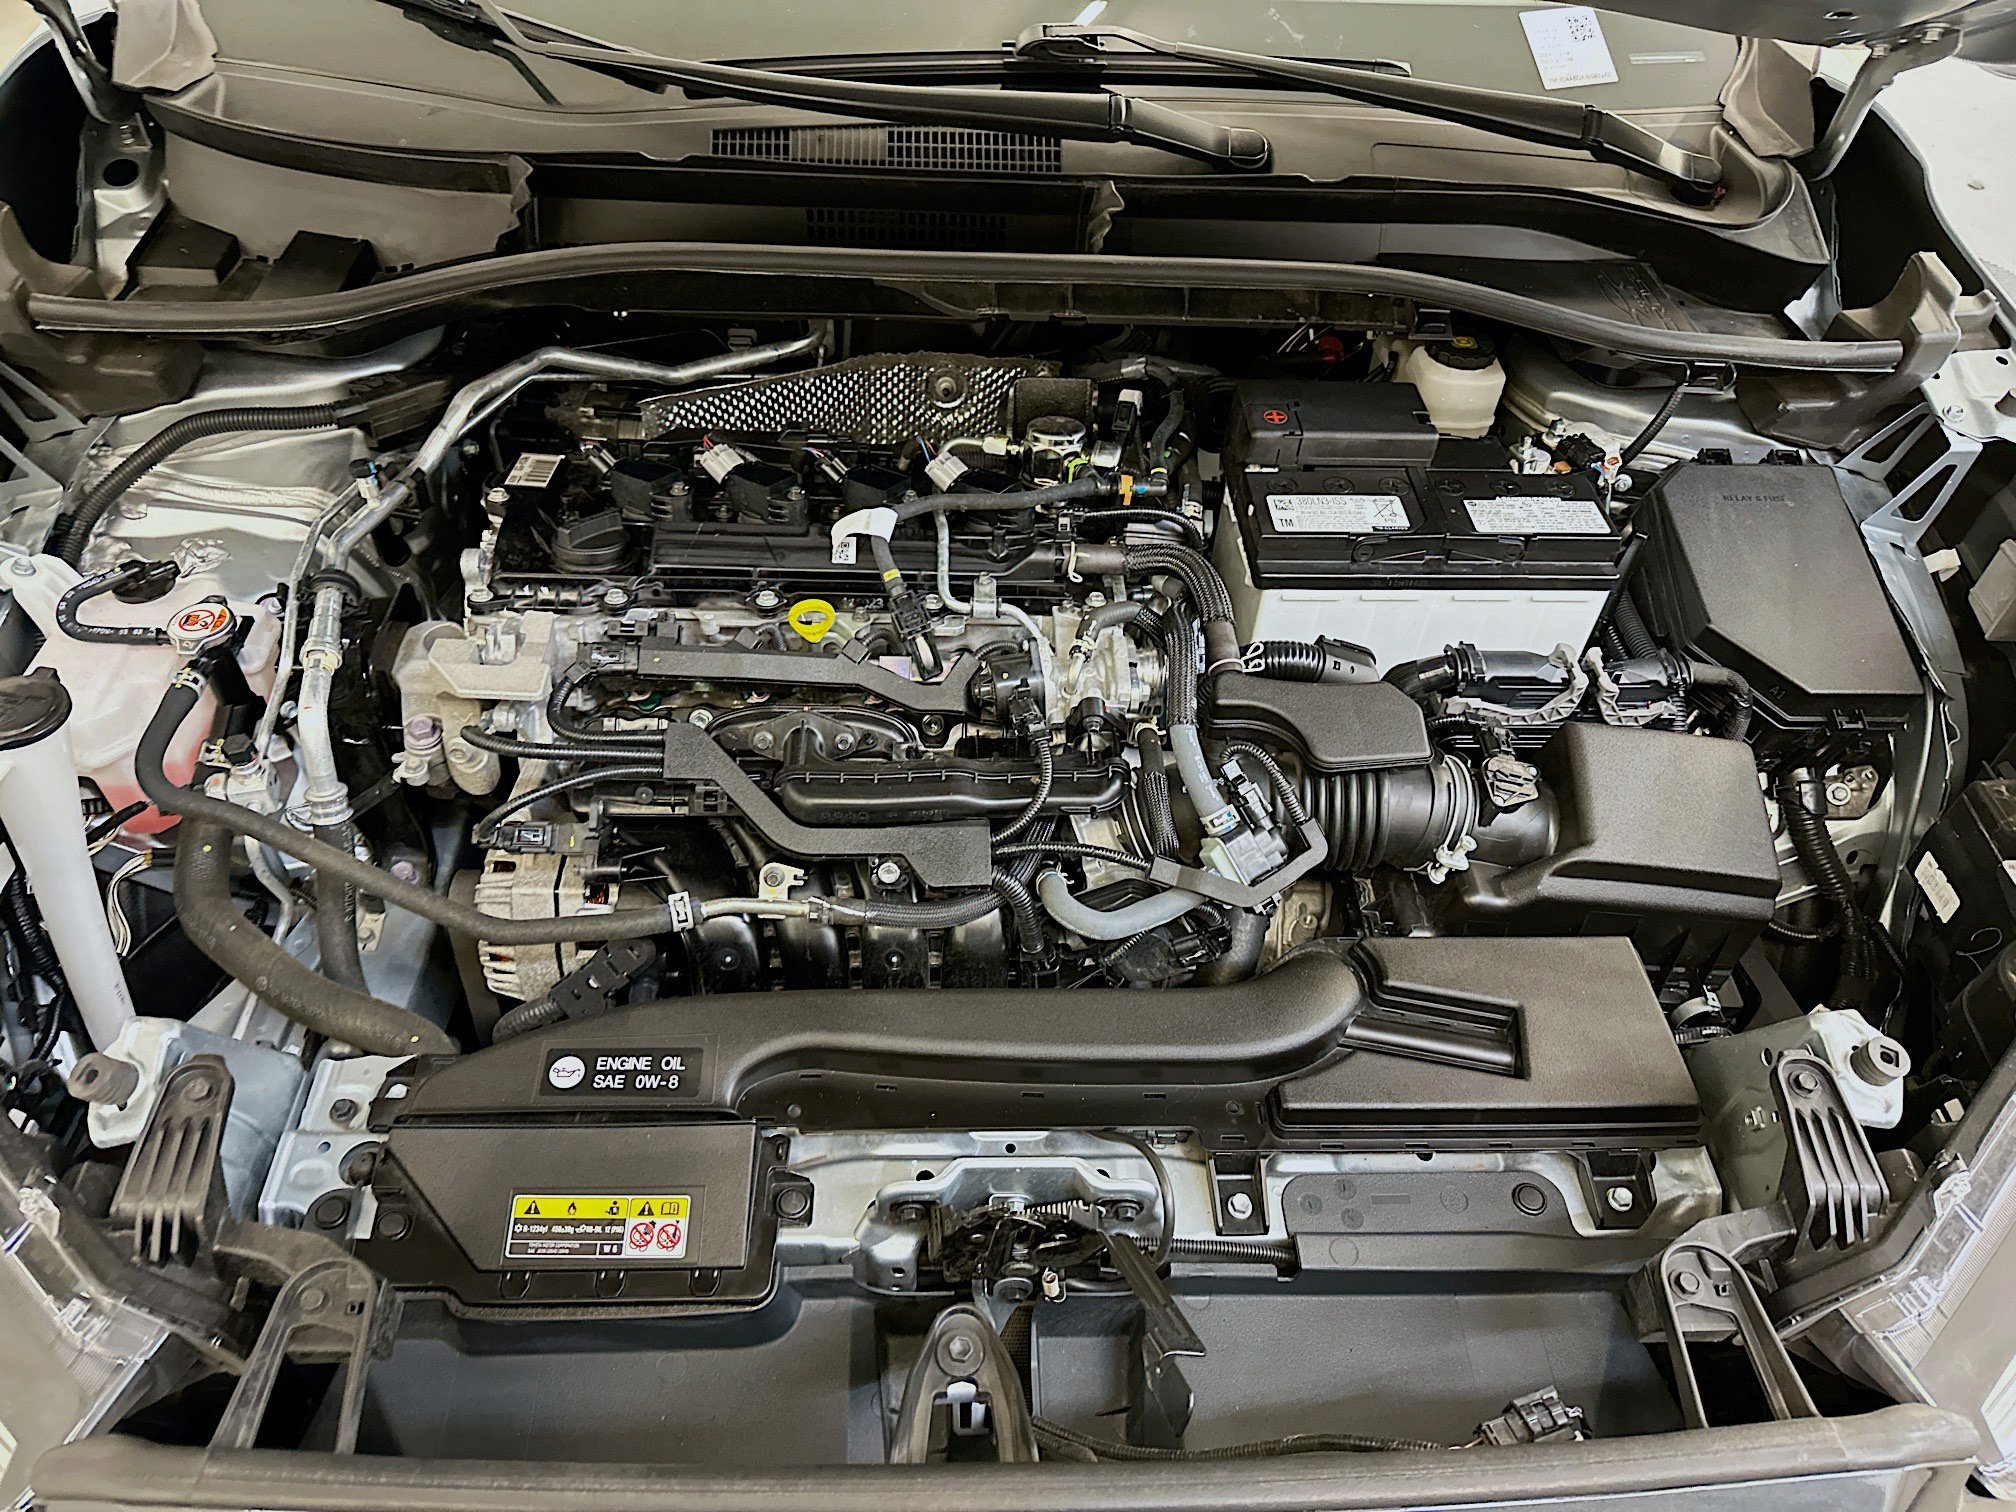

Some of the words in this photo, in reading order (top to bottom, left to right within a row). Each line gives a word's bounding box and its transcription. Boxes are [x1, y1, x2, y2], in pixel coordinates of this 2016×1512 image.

[1278, 518, 1294, 528] TM
[596, 1056, 652, 1071] ENGINE
[661, 1056, 686, 1071] OIL
[592, 1074, 625, 1089] SAE
[635, 1074, 679, 1089] 0W-8
[603, 1245, 611, 1253] W
